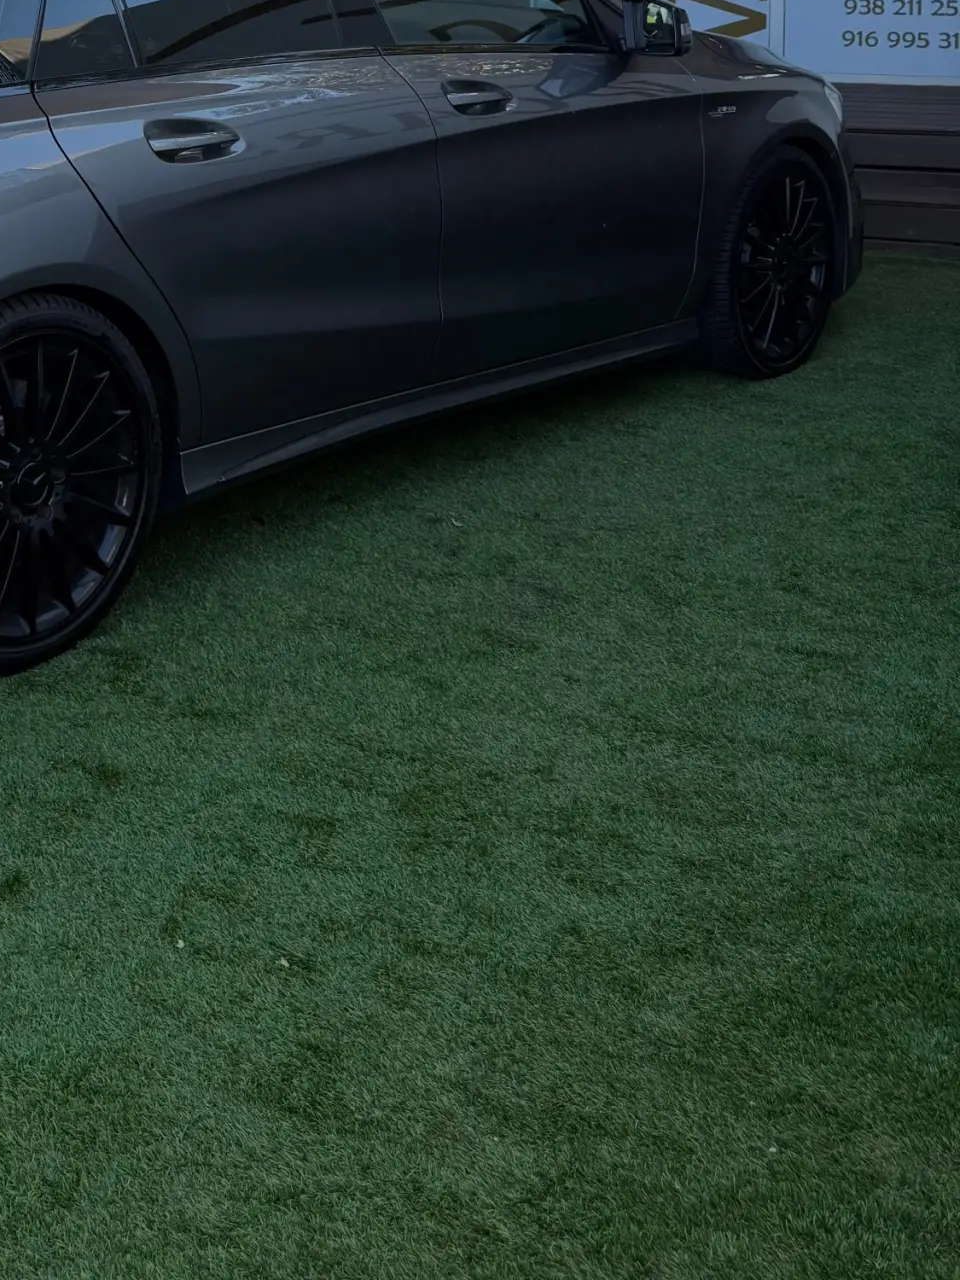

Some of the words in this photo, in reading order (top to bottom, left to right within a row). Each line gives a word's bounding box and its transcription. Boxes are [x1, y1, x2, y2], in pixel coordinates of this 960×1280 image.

[931, 0, 960, 17] 25
[842, 30, 879, 48] 916
[887, 31, 930, 49] 995
